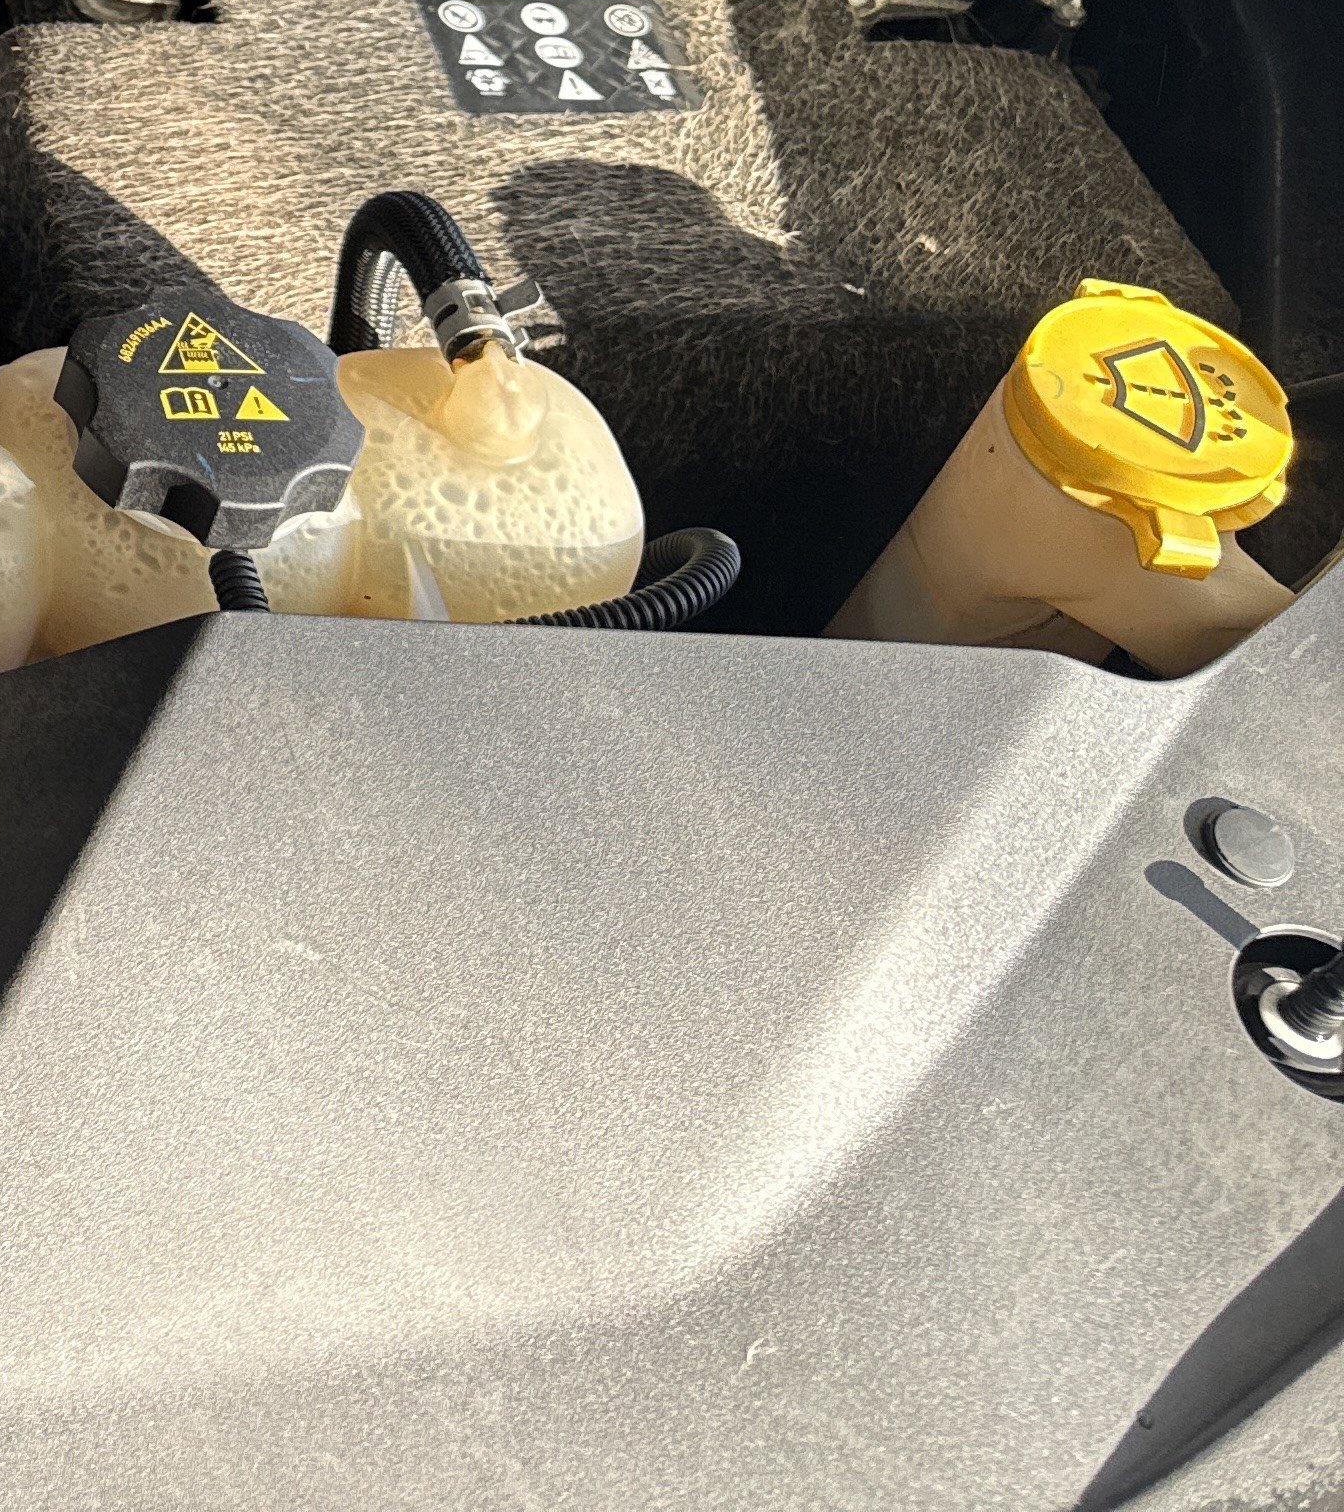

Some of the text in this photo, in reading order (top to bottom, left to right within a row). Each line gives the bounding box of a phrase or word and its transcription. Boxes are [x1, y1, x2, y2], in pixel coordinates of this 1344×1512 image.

[117, 316, 173, 363] 68249136AA
[217, 430, 254, 442] 21 PSI
[216, 442, 262, 454] 145 kPa
